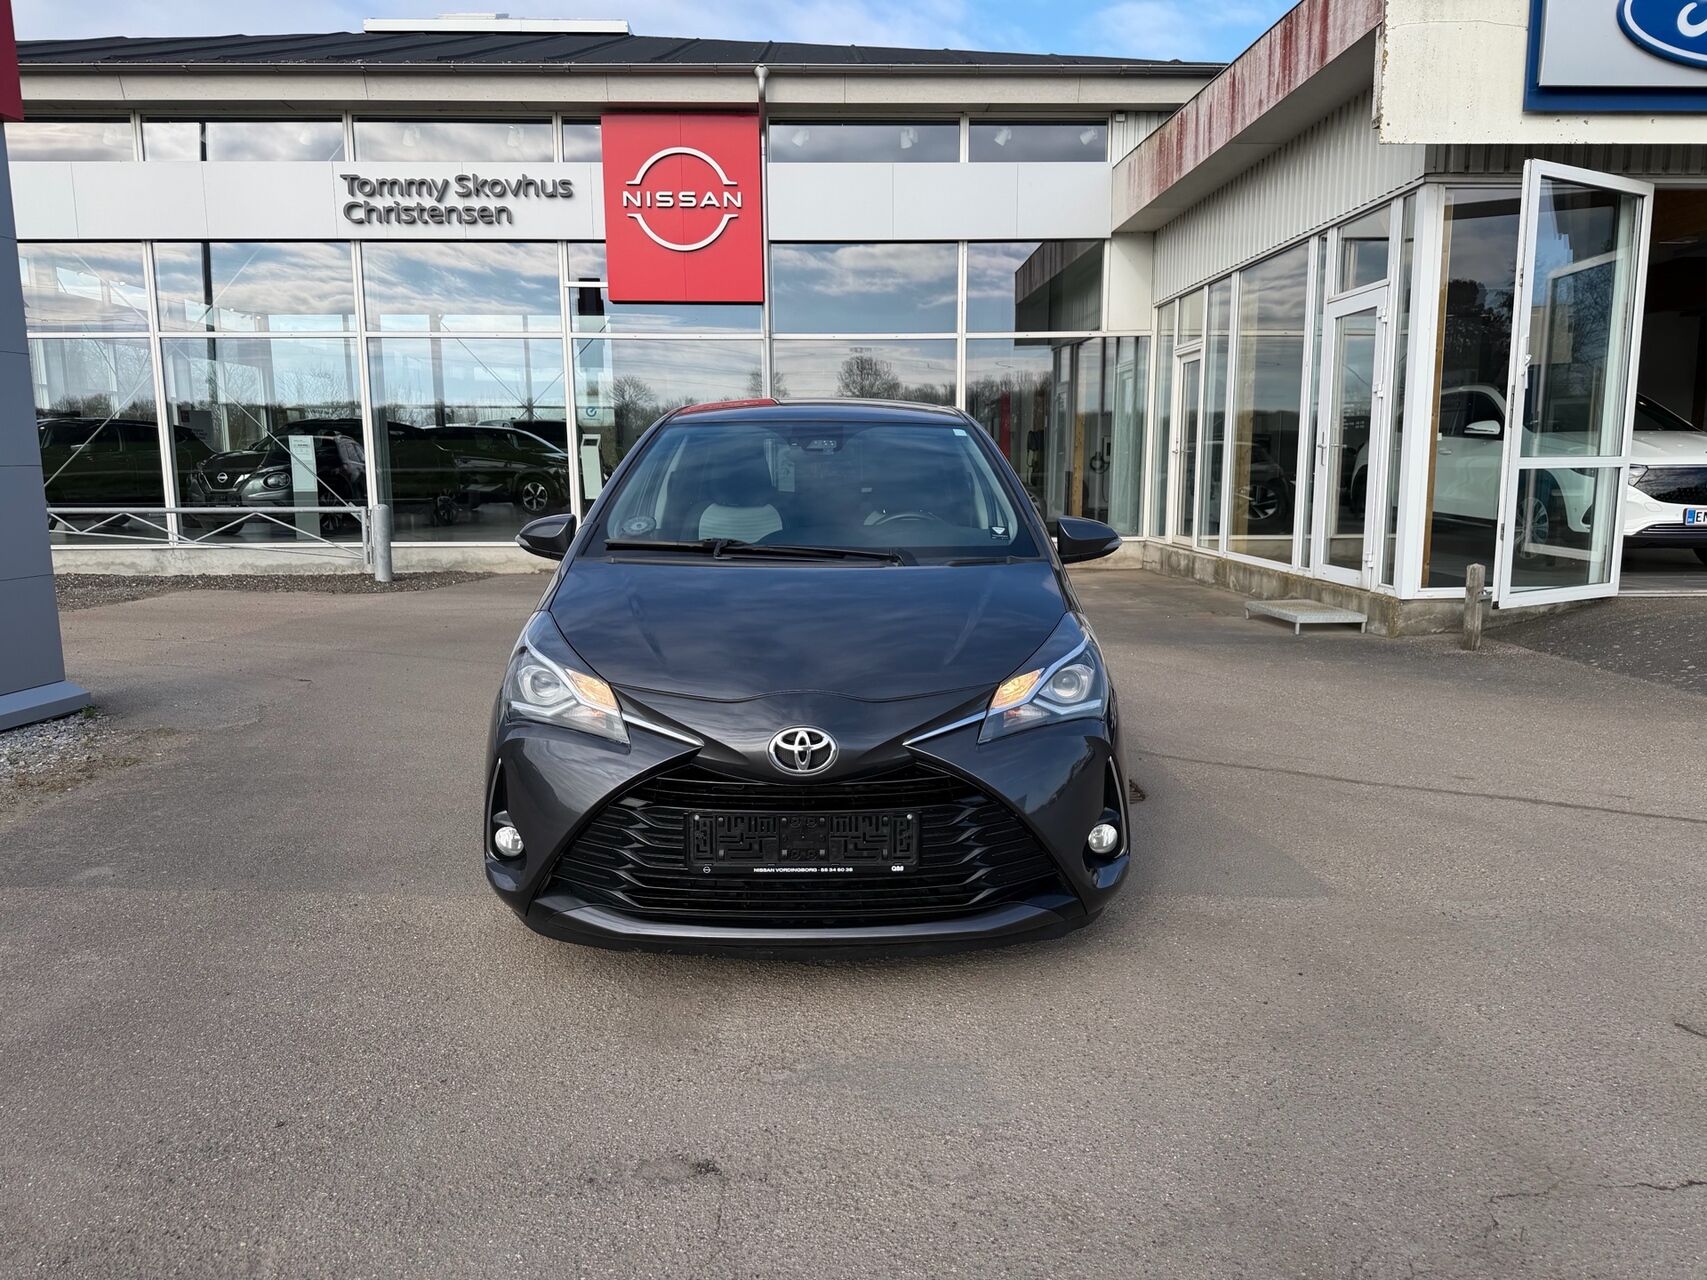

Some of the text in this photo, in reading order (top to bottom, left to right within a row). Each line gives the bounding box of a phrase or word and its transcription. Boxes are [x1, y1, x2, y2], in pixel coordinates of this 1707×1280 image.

[340, 174, 574, 202] Tommy Skovhus
[622, 190, 742, 208] NISSAN
[343, 201, 513, 225] Christensen
